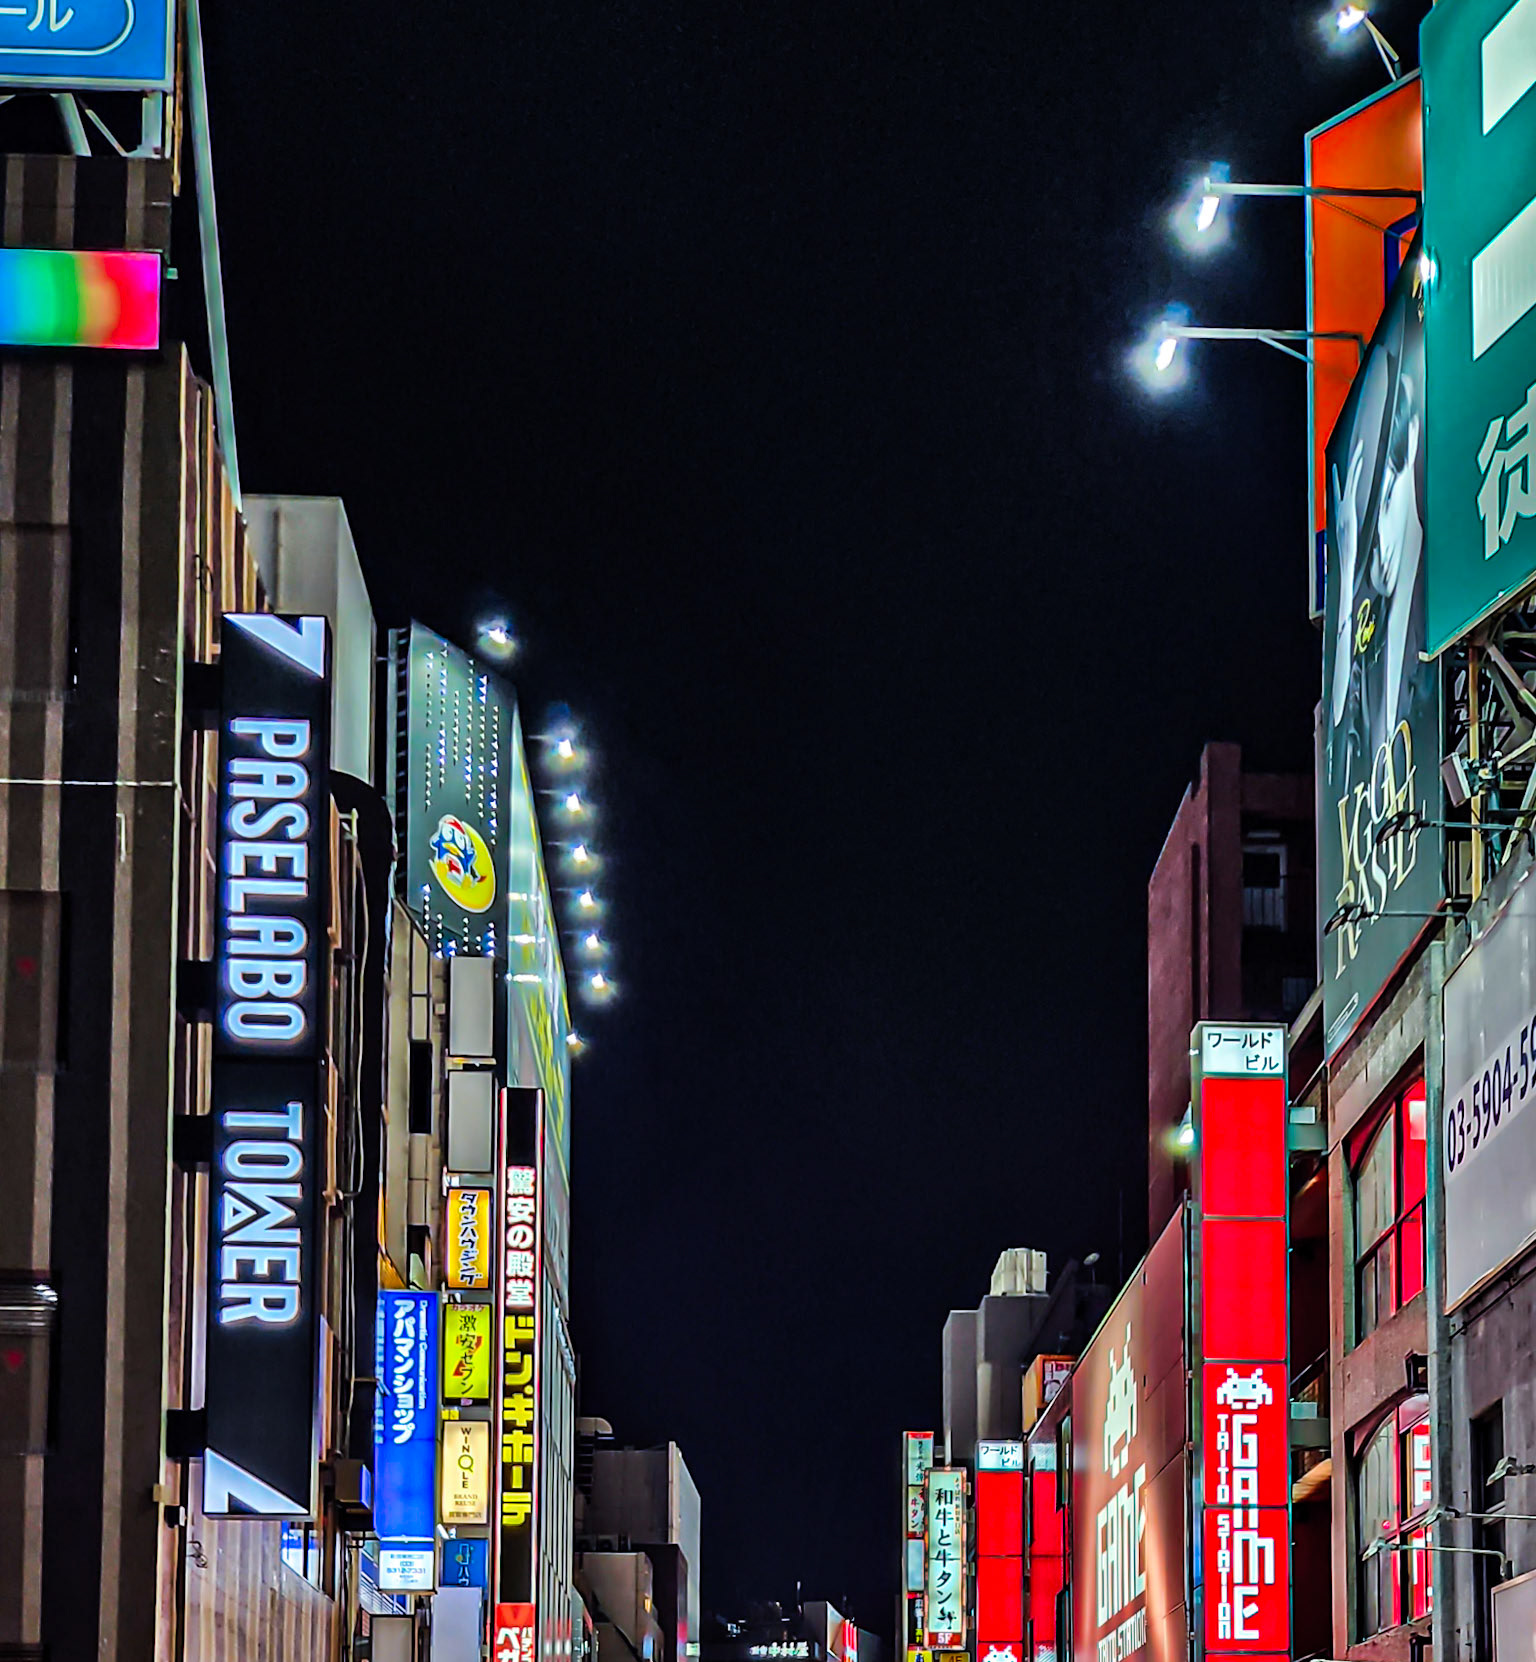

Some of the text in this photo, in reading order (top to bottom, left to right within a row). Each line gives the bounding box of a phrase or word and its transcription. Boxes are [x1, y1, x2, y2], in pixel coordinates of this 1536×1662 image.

[218, 715, 311, 1325] PASELABO TOWER
[1206, 1031, 1274, 1051] ワールド
[1244, 1053, 1280, 1072] ビル
[459, 1192, 483, 1286] タウンハウジング
[506, 1166, 536, 1307] 驚安の殿堂
[392, 1299, 416, 1445] アパマンショップ
[459, 1314, 477, 1395] 激安セブン
[457, 1426, 474, 1489] WINQLE
[935, 1487, 955, 1606] 和牛と牛タン
[1096, 1462, 1147, 1629] GAME
[1216, 1413, 1232, 1640] TAITO STATION
[1232, 1413, 1276, 1640] GAME
[937, 1632, 953, 1645] 5F
